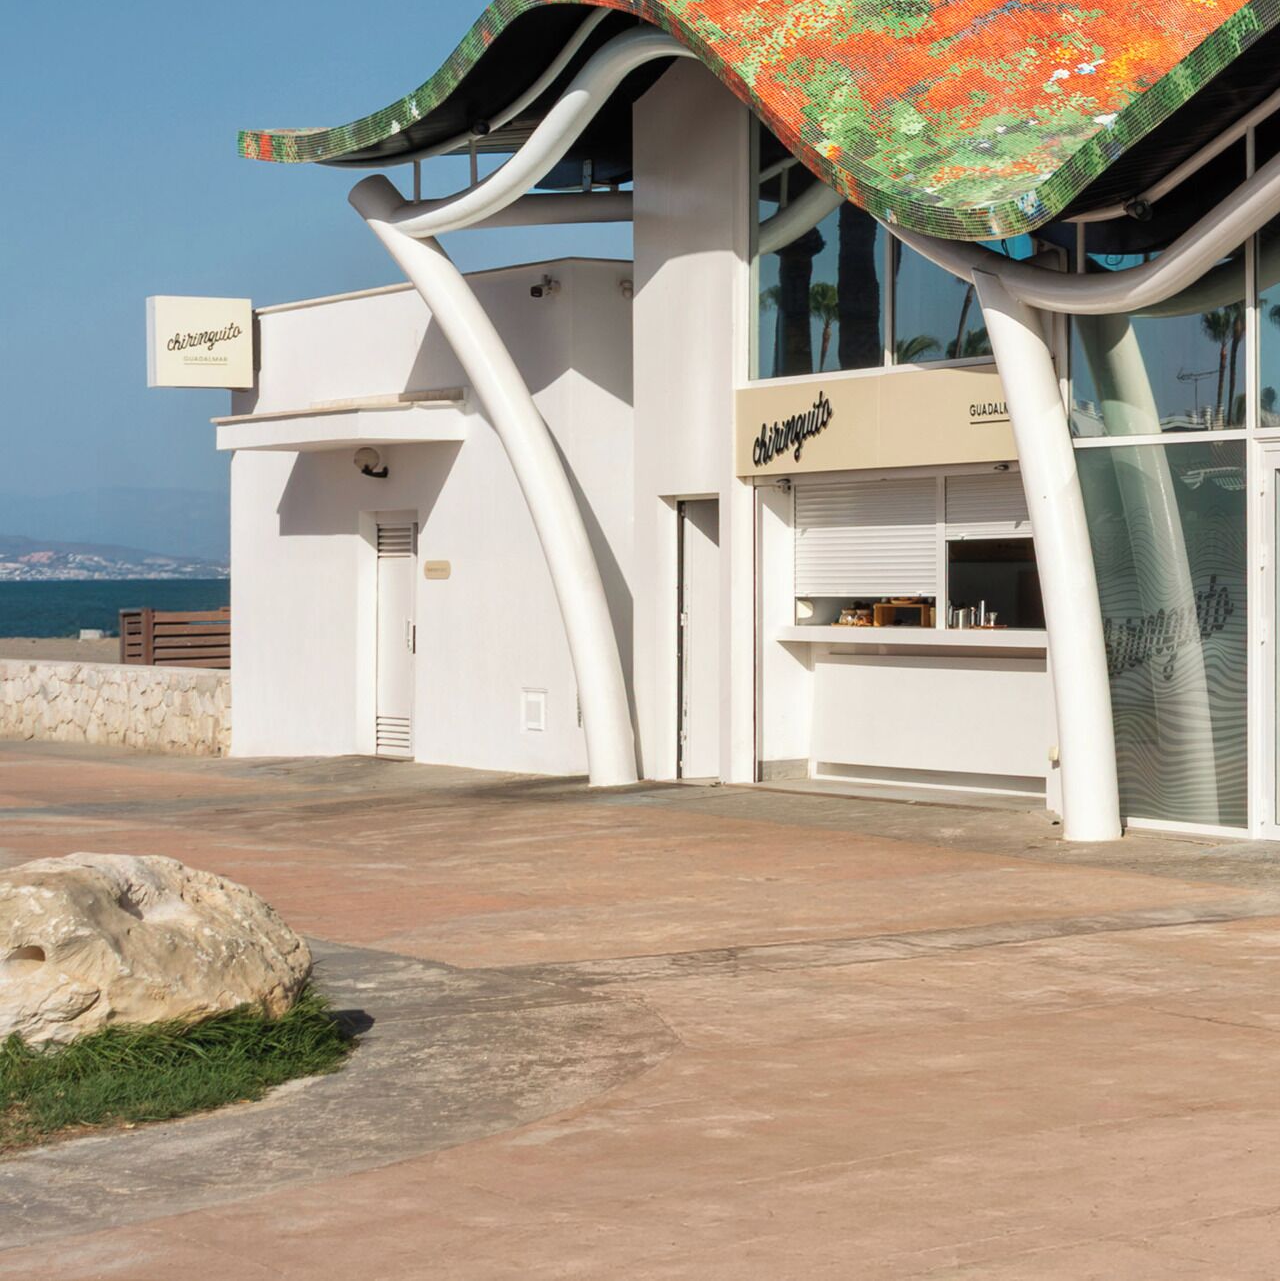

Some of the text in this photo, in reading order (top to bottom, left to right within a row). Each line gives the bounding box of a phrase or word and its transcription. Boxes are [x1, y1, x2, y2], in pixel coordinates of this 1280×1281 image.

[167, 322, 242, 351] chiringuito
[753, 390, 833, 468] chiringuito
[969, 401, 1009, 417] GUADALM
[1103, 573, 1234, 681] hiringuito
